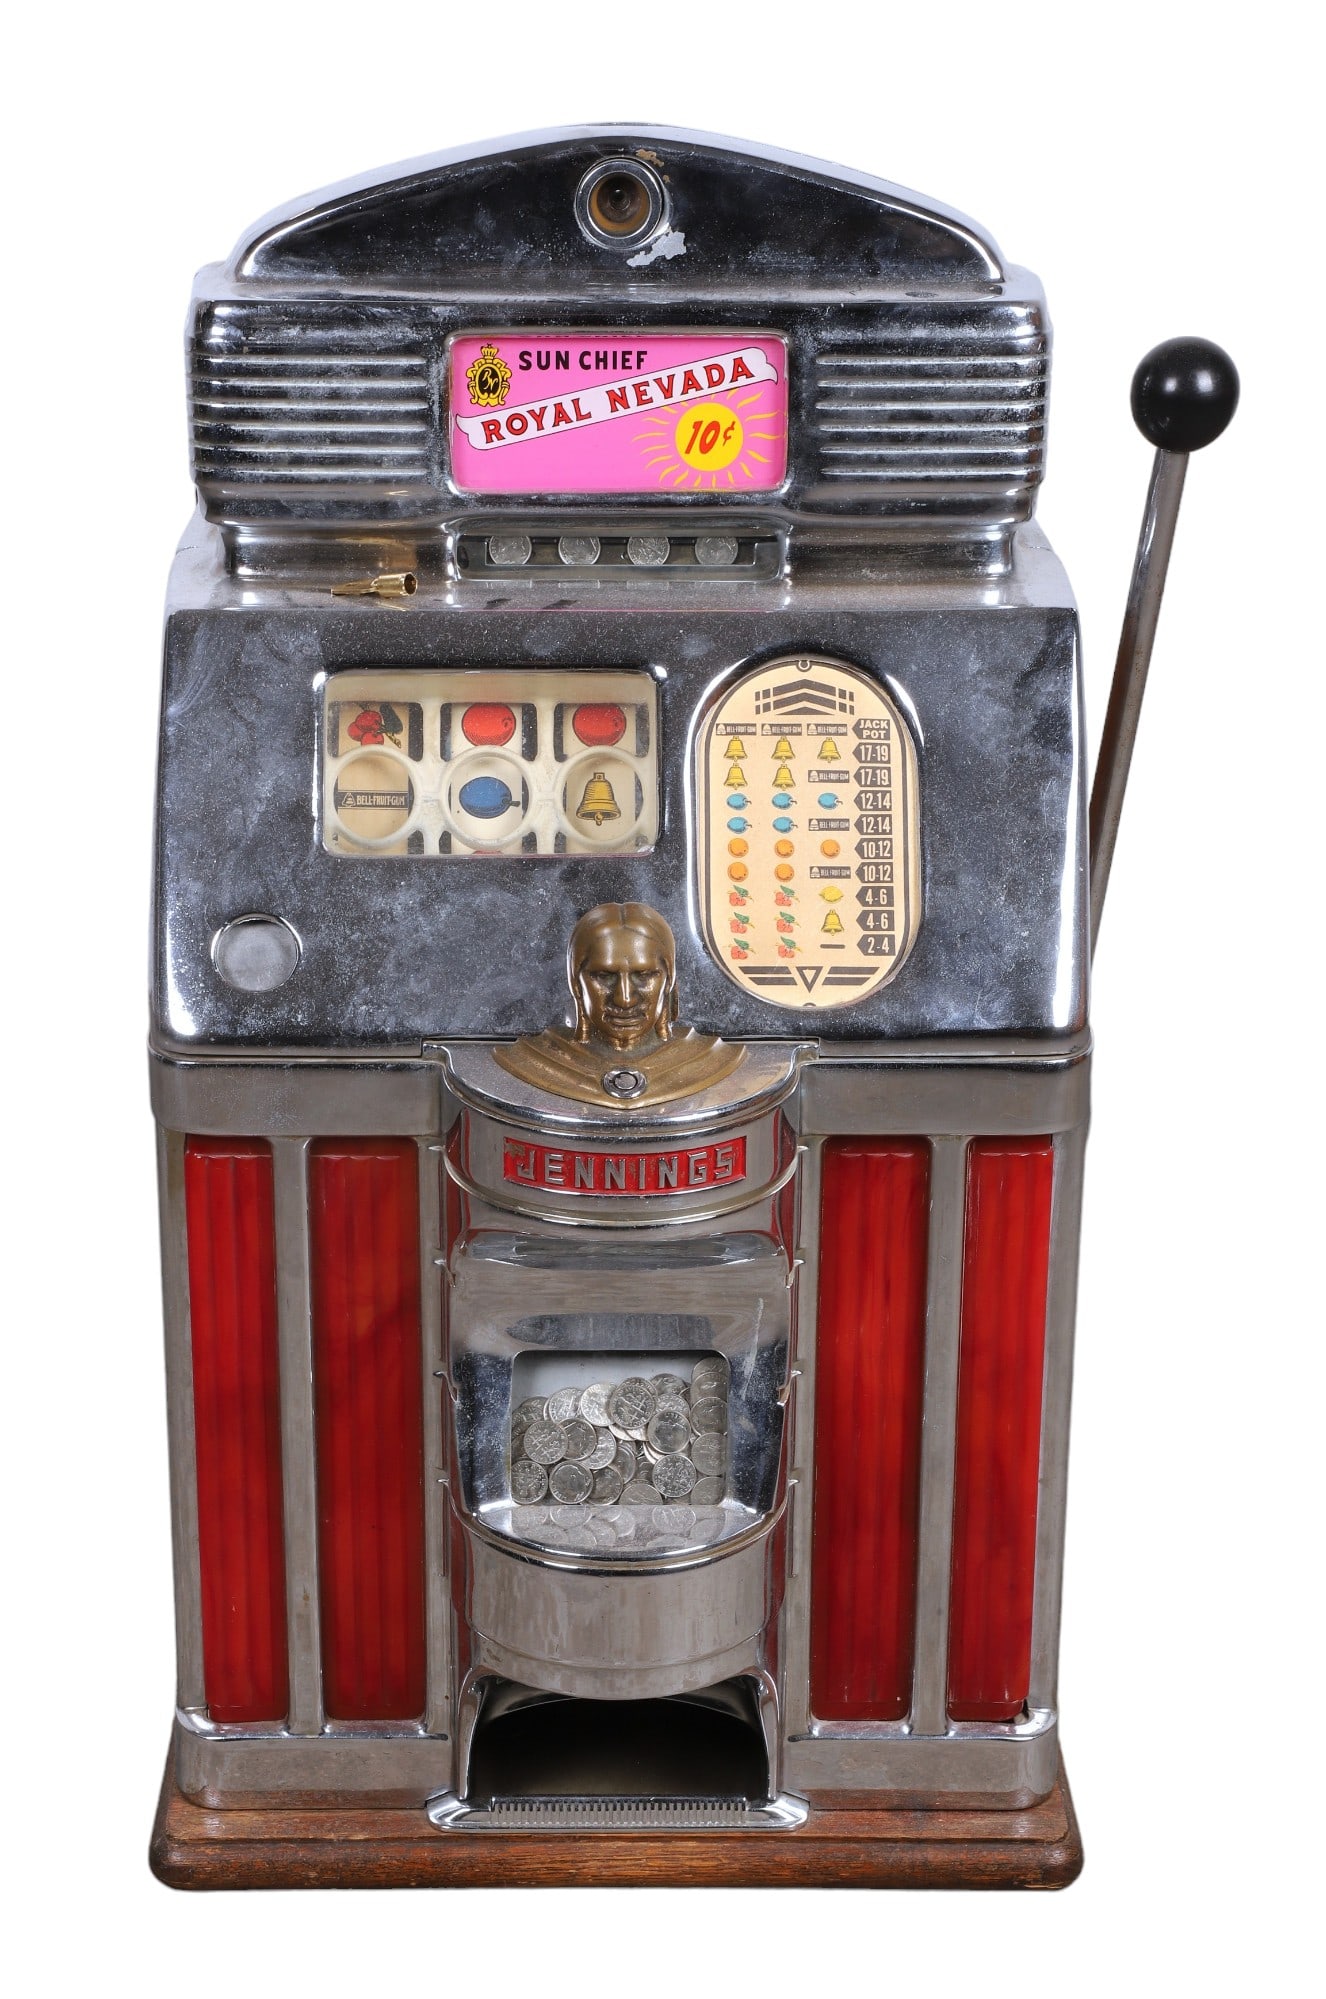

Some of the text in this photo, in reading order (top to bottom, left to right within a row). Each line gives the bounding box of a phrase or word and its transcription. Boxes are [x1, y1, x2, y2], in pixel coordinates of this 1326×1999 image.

[518, 350, 648, 371] SUN CHIEF
[481, 356, 755, 444] ROYAL NEVADA
[684, 420, 736, 455] 10¢
[859, 719, 889, 729] JACK
[862, 730, 887, 739] POT
[860, 744, 889, 762] 17-19
[860, 768, 890, 786] 17-19
[356, 794, 406, 806] BELL-FRUIT-GUM
[860, 792, 891, 809] 12-14
[861, 816, 891, 833] 12-14
[862, 840, 891, 858] 10-12
[862, 864, 891, 882] 10-12
[865, 888, 888, 905] 4-6
[866, 912, 889, 929] 4-6
[867, 936, 890, 954] 2-4
[516, 1146, 734, 1190] JENNINGS
